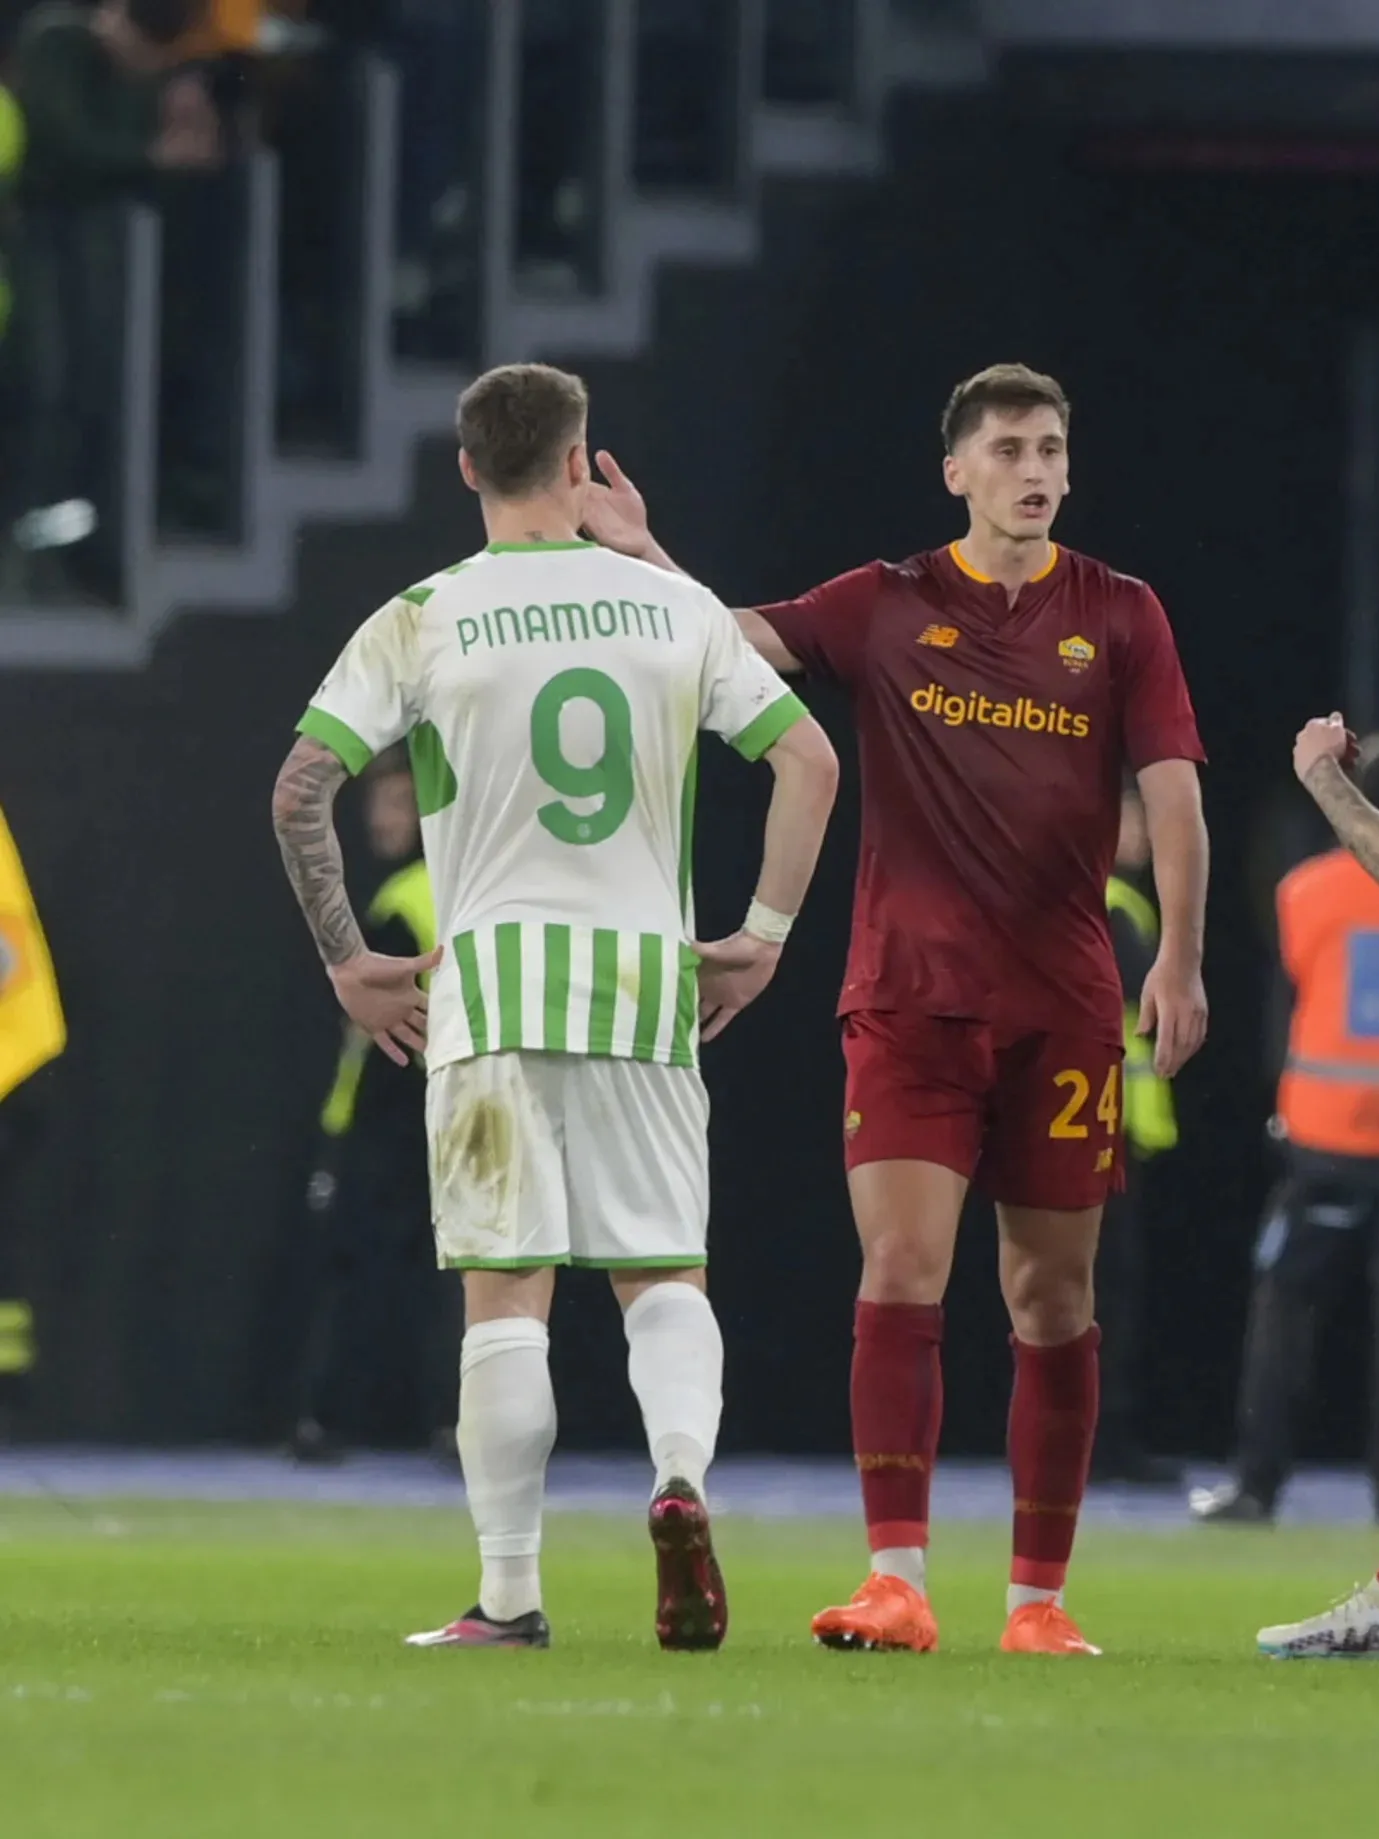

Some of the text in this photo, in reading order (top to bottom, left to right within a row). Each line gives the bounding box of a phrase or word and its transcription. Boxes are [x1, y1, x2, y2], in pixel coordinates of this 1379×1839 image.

[456, 600, 674, 655] PINAMONTI
[910, 683, 1090, 737] digitalbits
[530, 667, 634, 846] 9
[1049, 1065, 1118, 1139] 24
